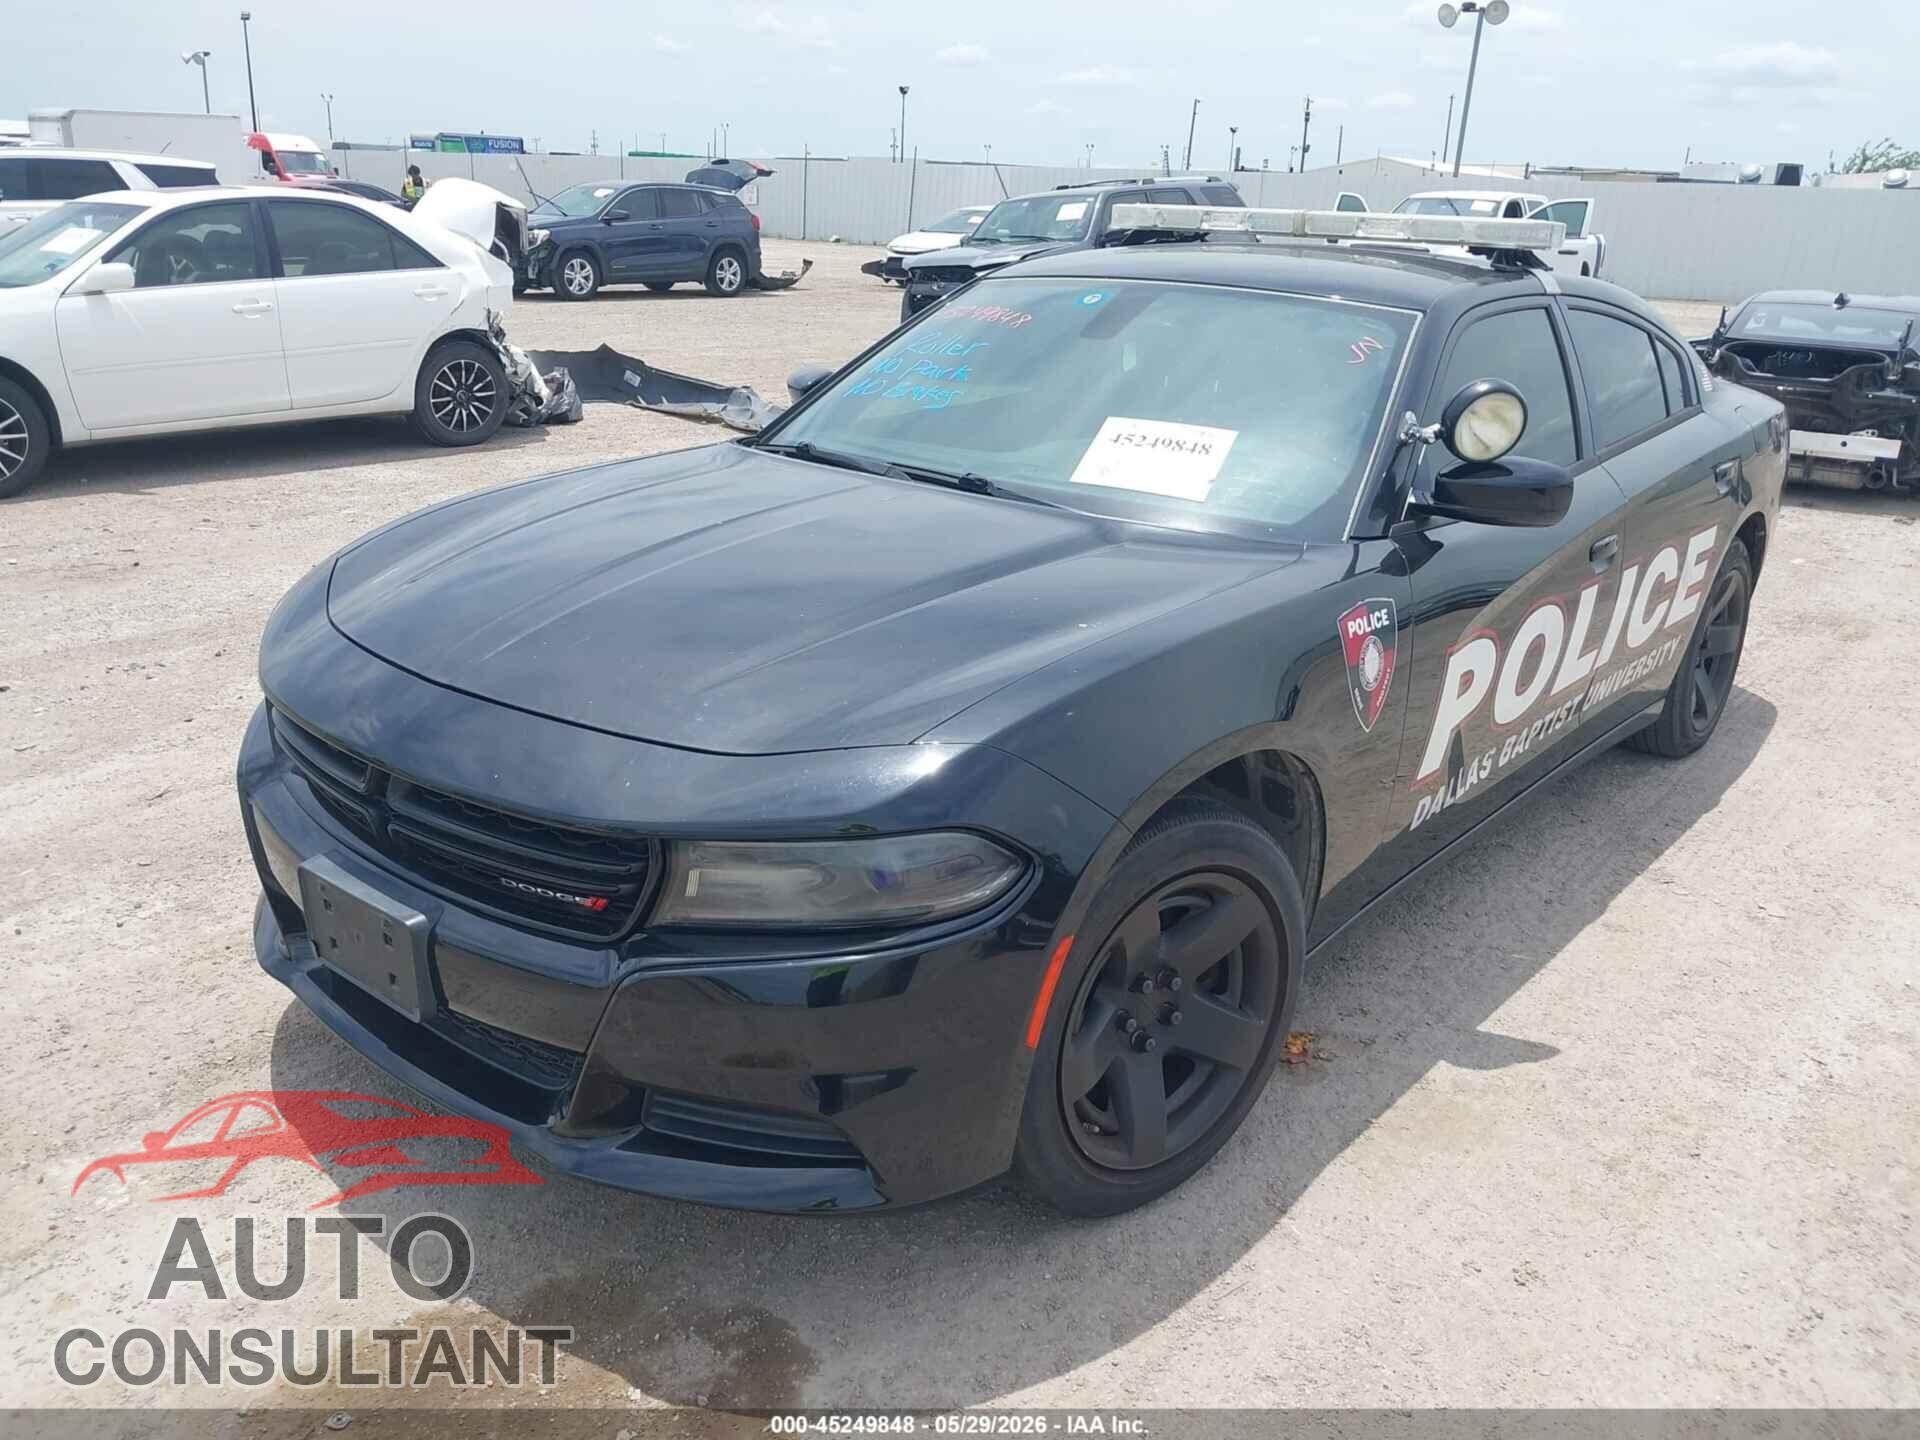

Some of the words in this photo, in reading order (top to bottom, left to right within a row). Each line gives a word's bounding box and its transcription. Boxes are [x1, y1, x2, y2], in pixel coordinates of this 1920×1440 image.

[487, 138, 520, 150] FUSION
[1109, 433, 1212, 455] 45249848
[1347, 608, 1390, 640] POLICE
[1412, 525, 1718, 786] POLICE
[1409, 748, 1496, 832] DALLAS
[1499, 693, 1584, 768] BAPTIST
[1582, 633, 1682, 713] UNIVERSITY
[501, 877, 594, 907] DODGE
